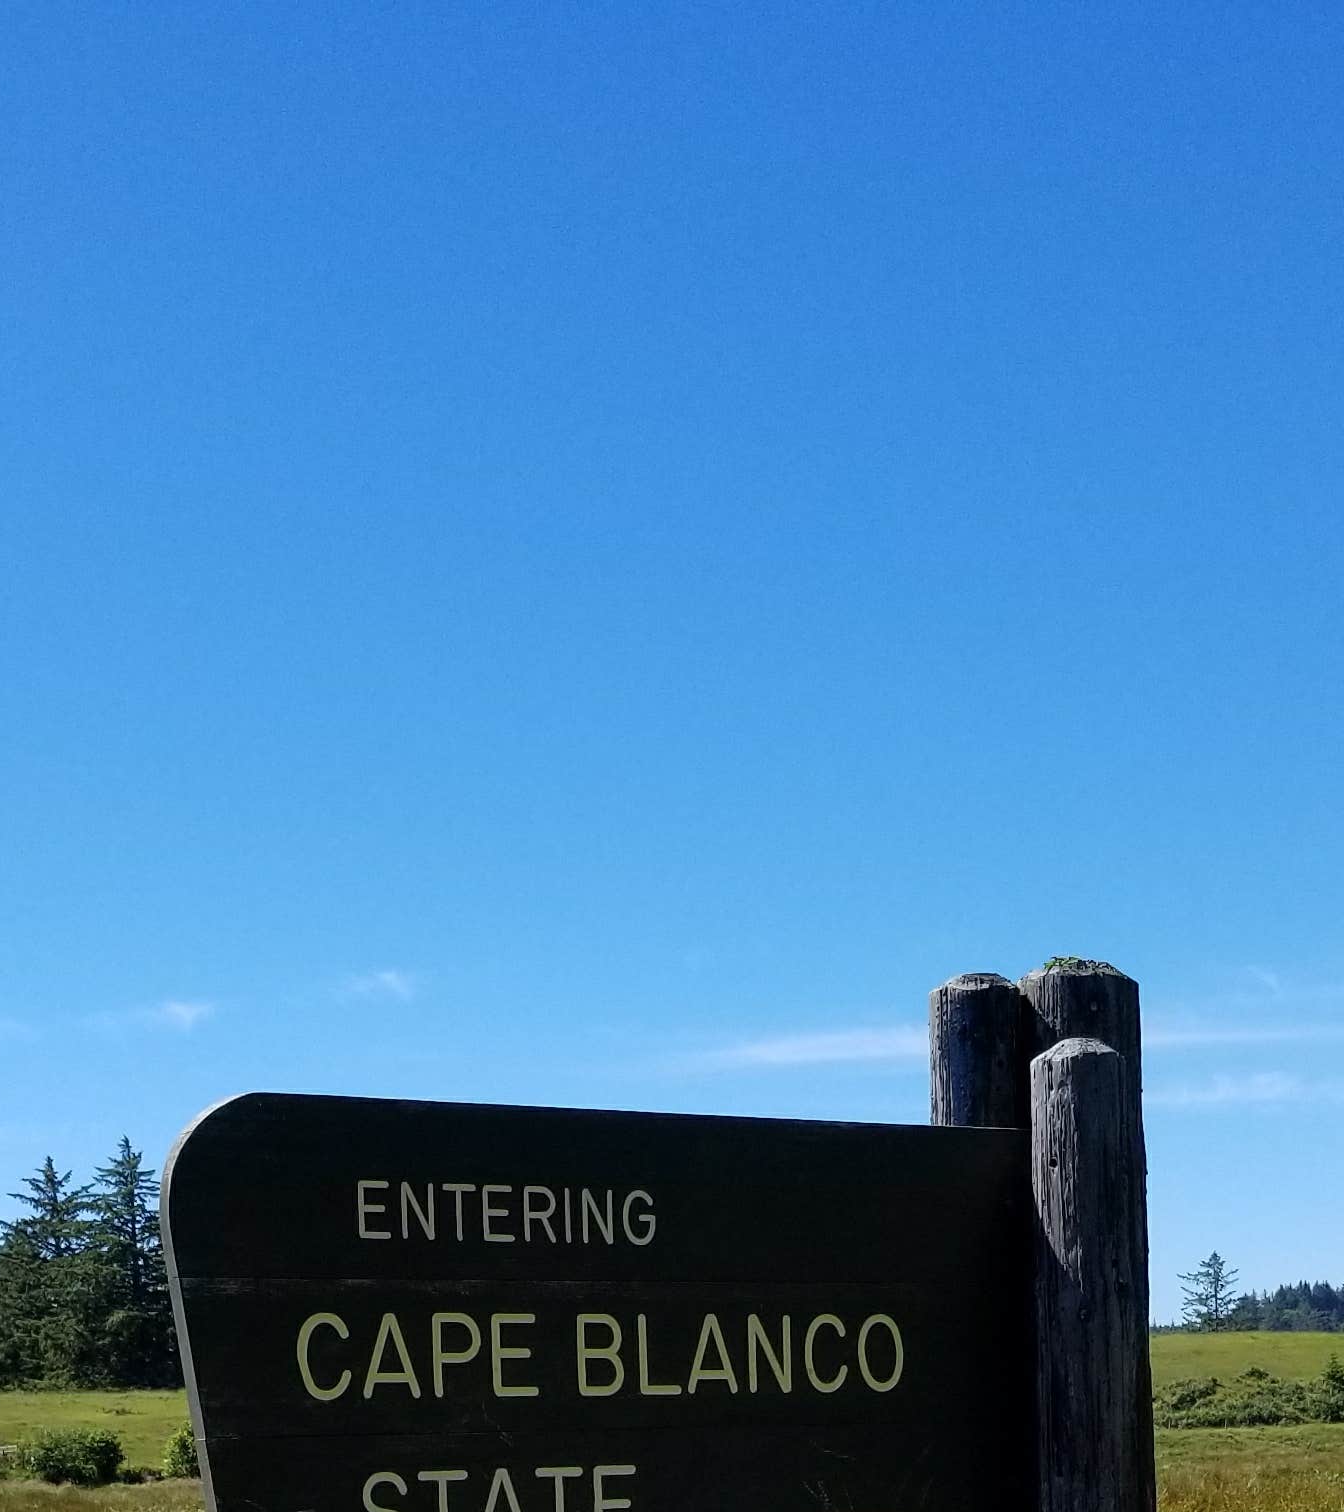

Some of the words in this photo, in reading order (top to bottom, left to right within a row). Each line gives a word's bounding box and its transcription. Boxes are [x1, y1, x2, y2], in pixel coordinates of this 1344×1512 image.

[357, 1179, 657, 1246] ENTERING
[295, 1311, 540, 1401] CAPE
[576, 1312, 905, 1395] BLANCO
